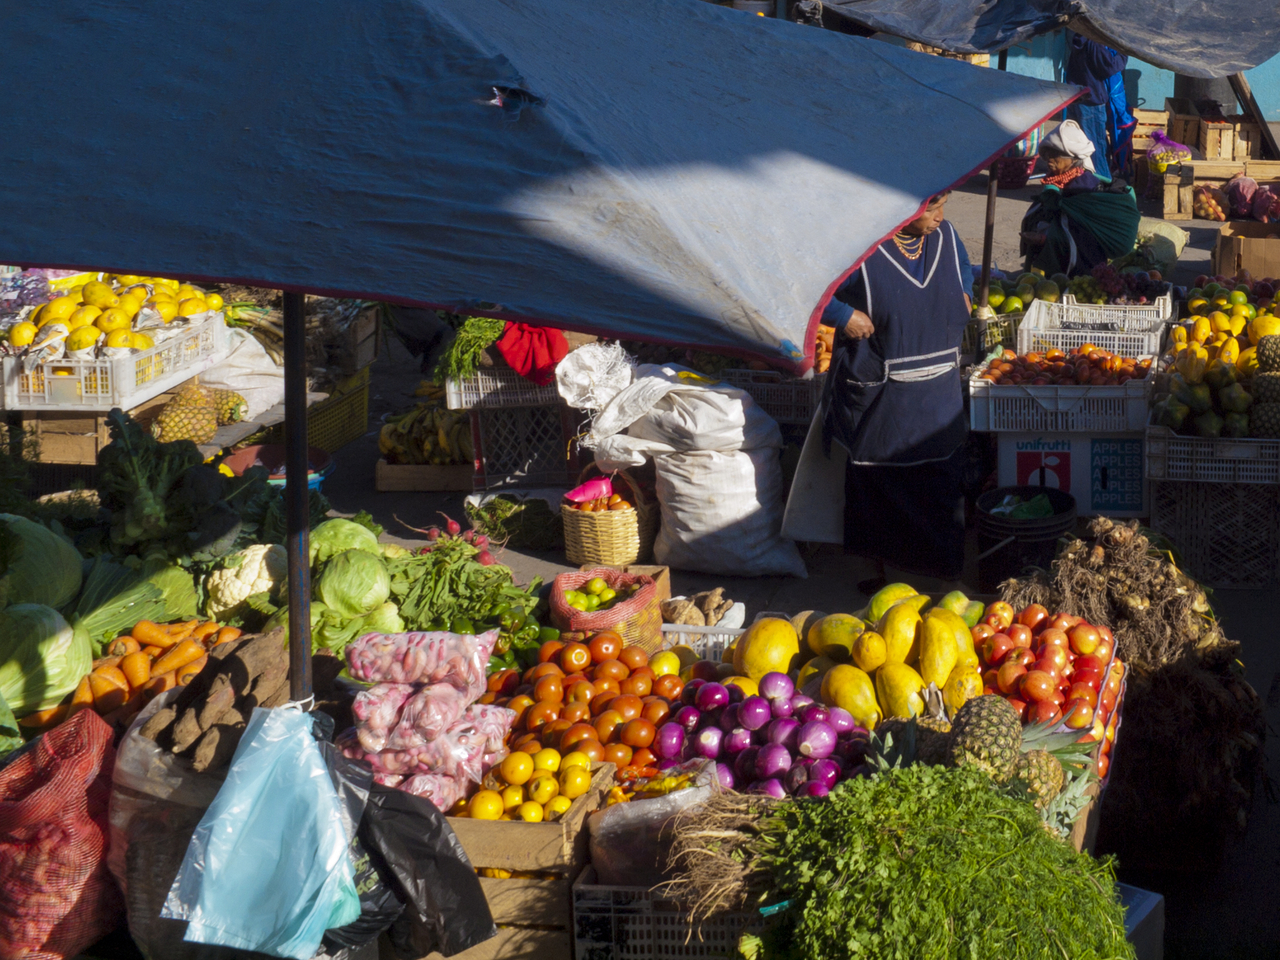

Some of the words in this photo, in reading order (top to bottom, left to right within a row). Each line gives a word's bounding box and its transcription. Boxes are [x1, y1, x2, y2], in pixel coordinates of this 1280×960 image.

[1016, 437, 1071, 451] unifrutti
[1093, 443, 1141, 453] APPLES
[1093, 456, 1141, 466] APPLES
[1093, 469, 1141, 479] APLES
[1093, 481, 1141, 491] APLES
[1093, 493, 1141, 504] APPLES
